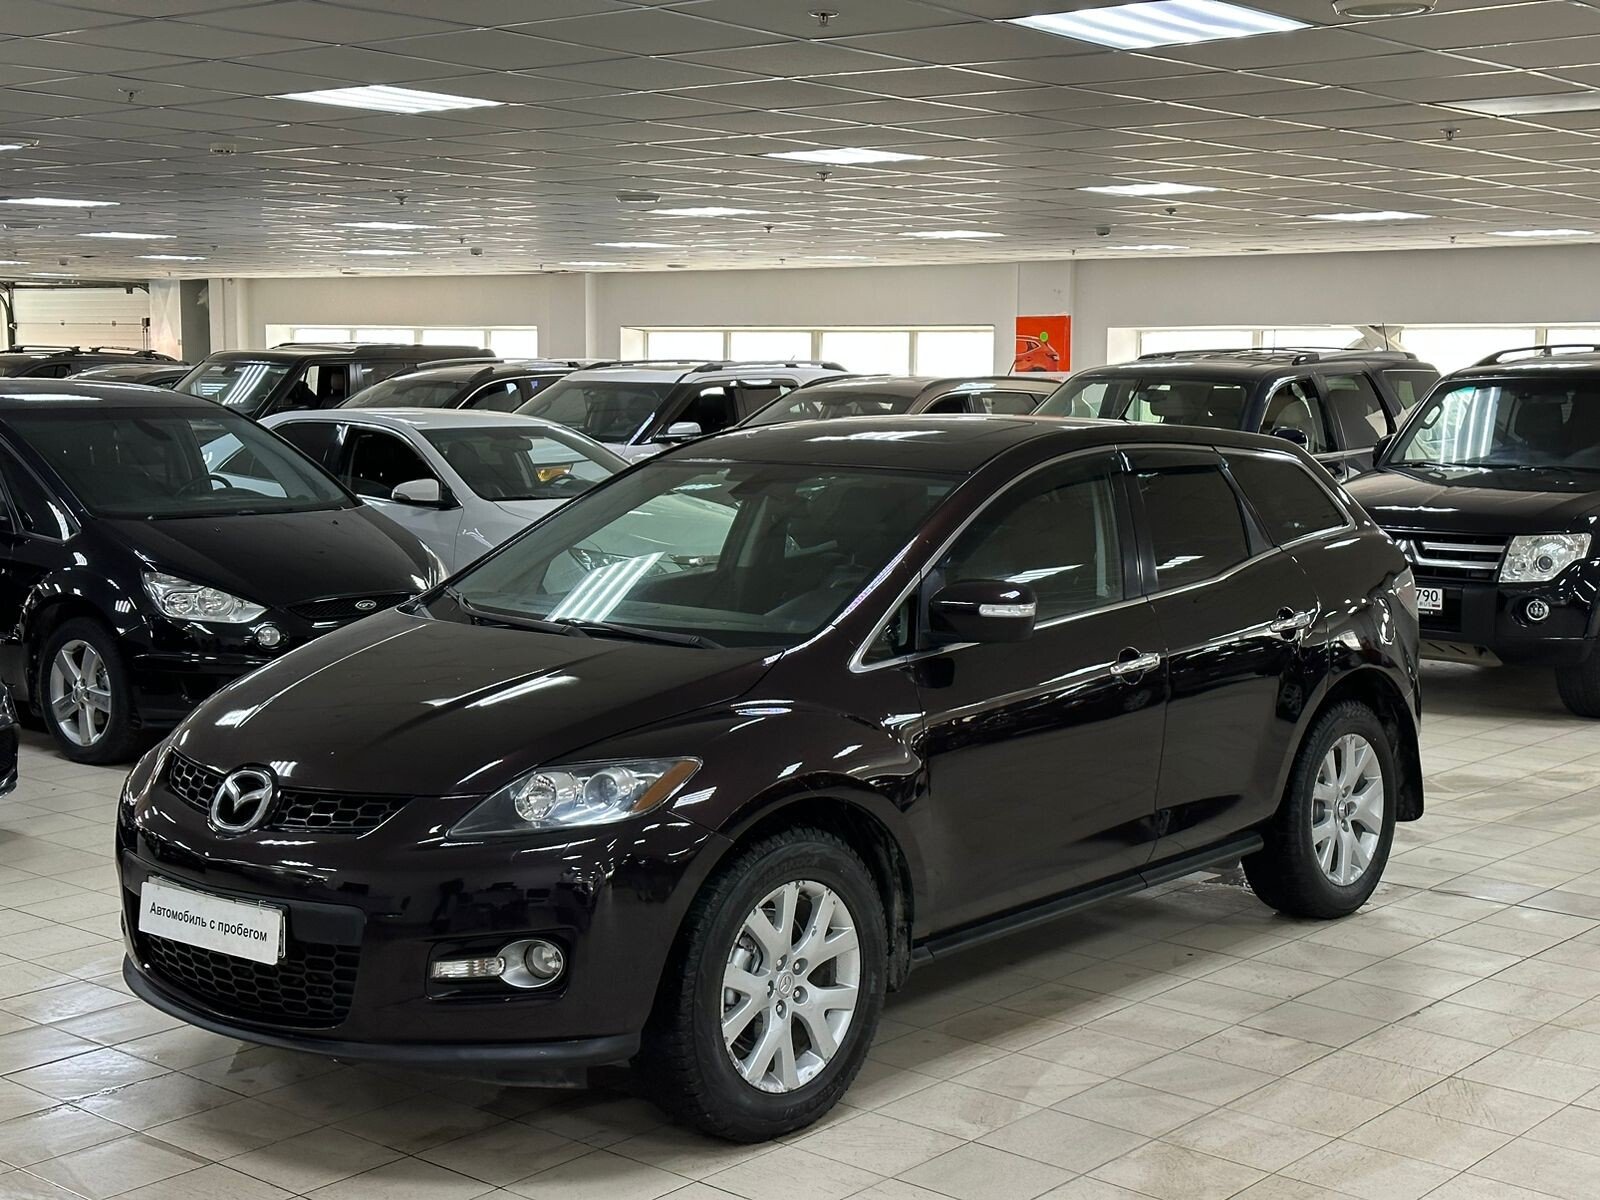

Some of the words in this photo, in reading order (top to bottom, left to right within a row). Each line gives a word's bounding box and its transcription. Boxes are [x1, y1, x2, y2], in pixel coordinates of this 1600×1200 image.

[1416, 589, 1438, 602] 790
[149, 901, 207, 928] Автомобиль
[209, 919, 215, 930] с
[217, 921, 267, 942] пробегом
